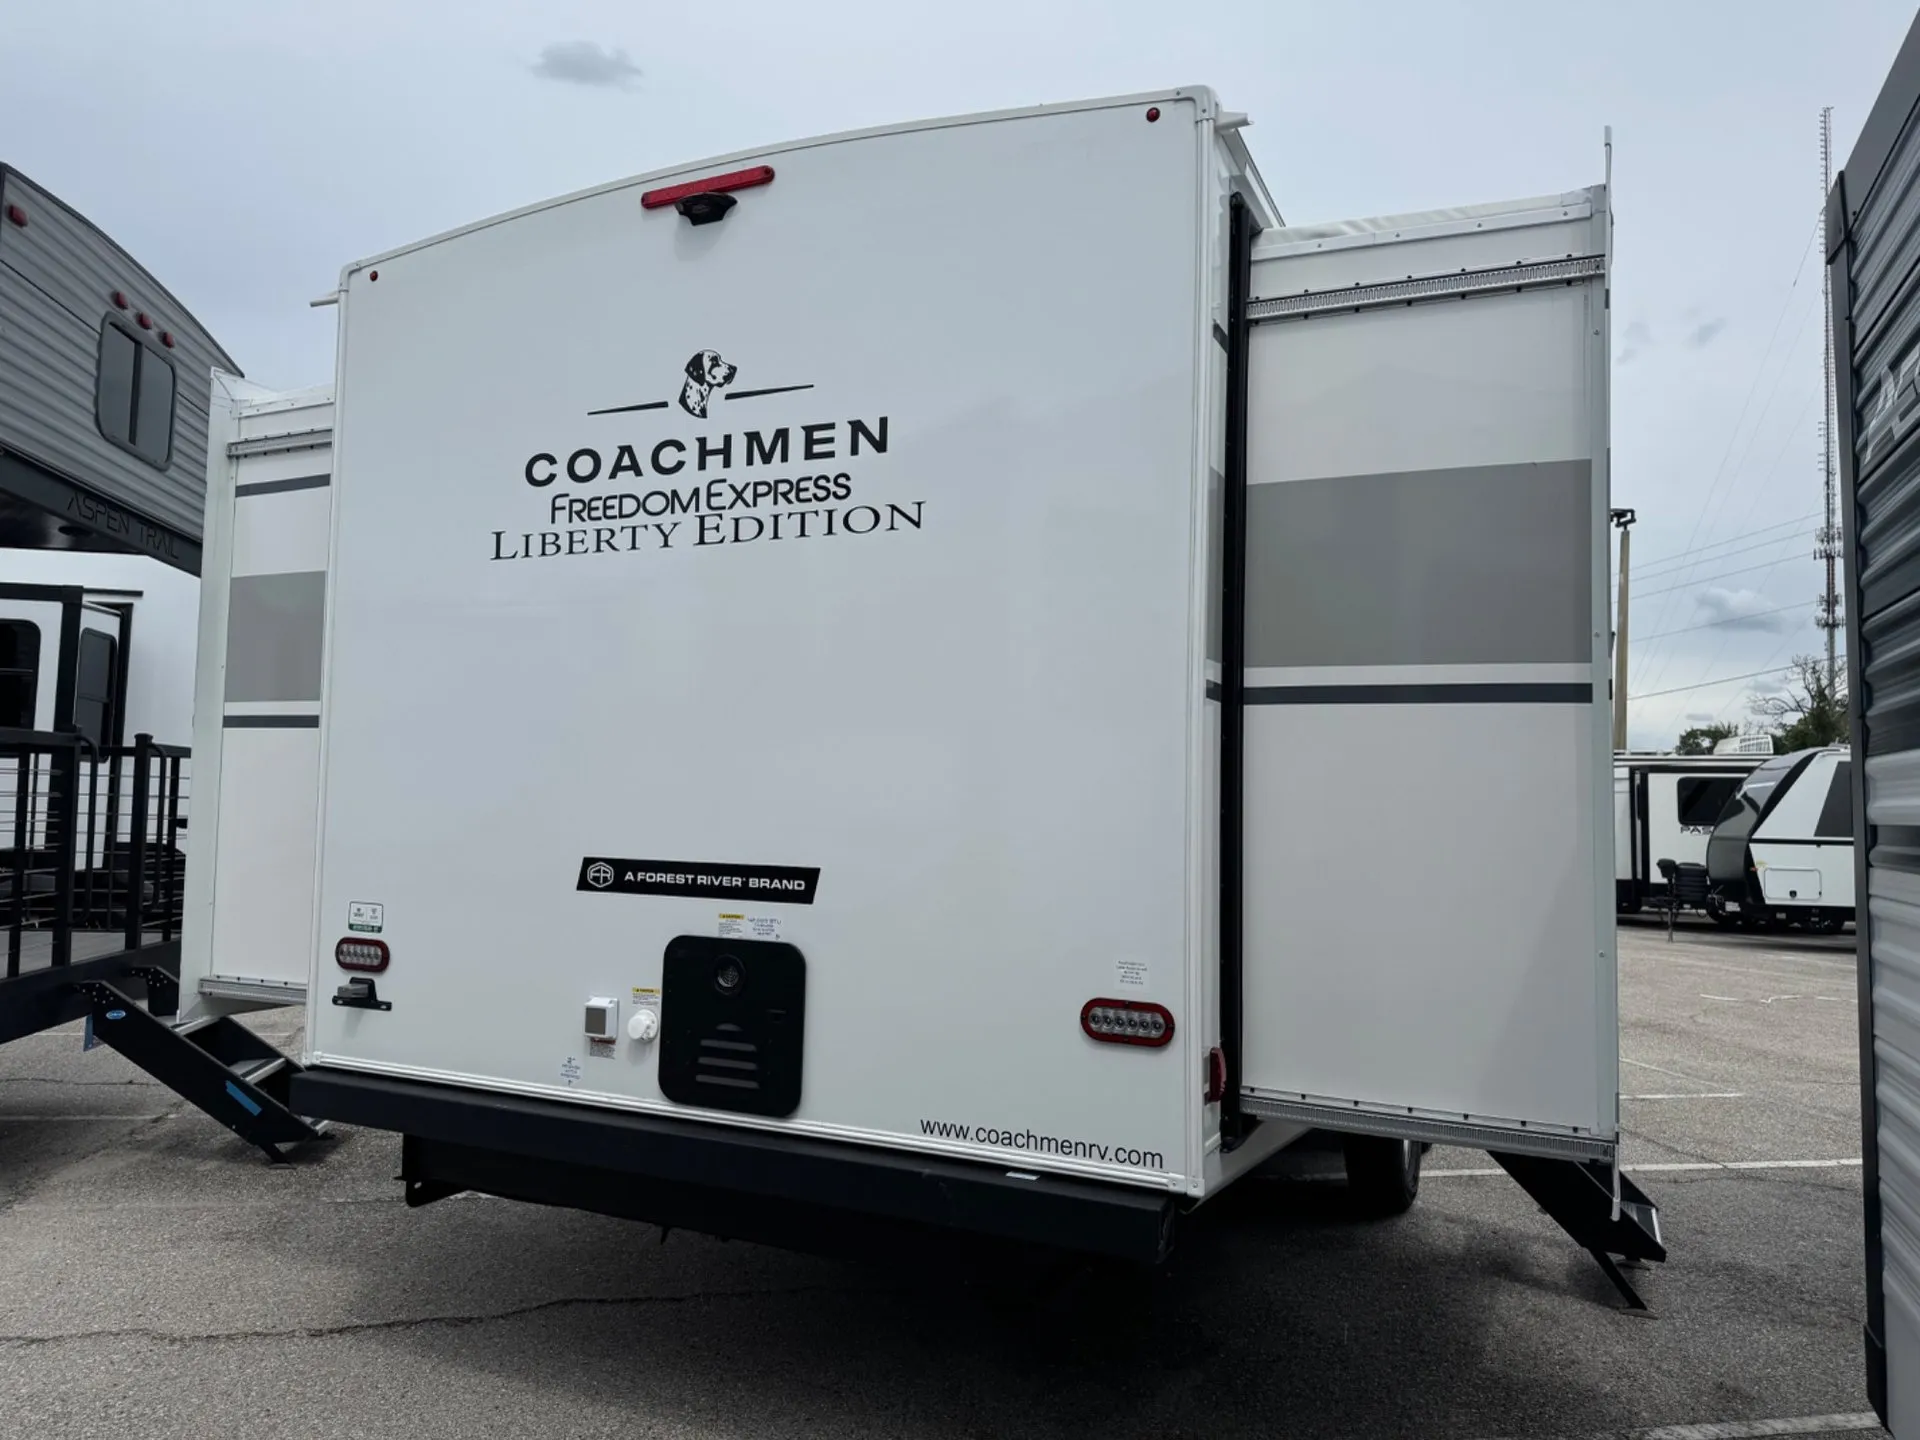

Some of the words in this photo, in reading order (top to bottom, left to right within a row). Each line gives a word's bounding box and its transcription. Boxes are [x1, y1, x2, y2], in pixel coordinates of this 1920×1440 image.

[524, 415, 889, 488] COACHMEN
[67, 491, 131, 535] ASPEN
[137, 519, 180, 561] TRAIL
[490, 521, 682, 561] LIBERTY
[692, 500, 927, 546] EDITION
[624, 871, 635, 882] A
[636, 871, 695, 885] FOREST
[748, 877, 806, 891] BRAND
[920, 1118, 1164, 1170] www.coachmenrv.com
